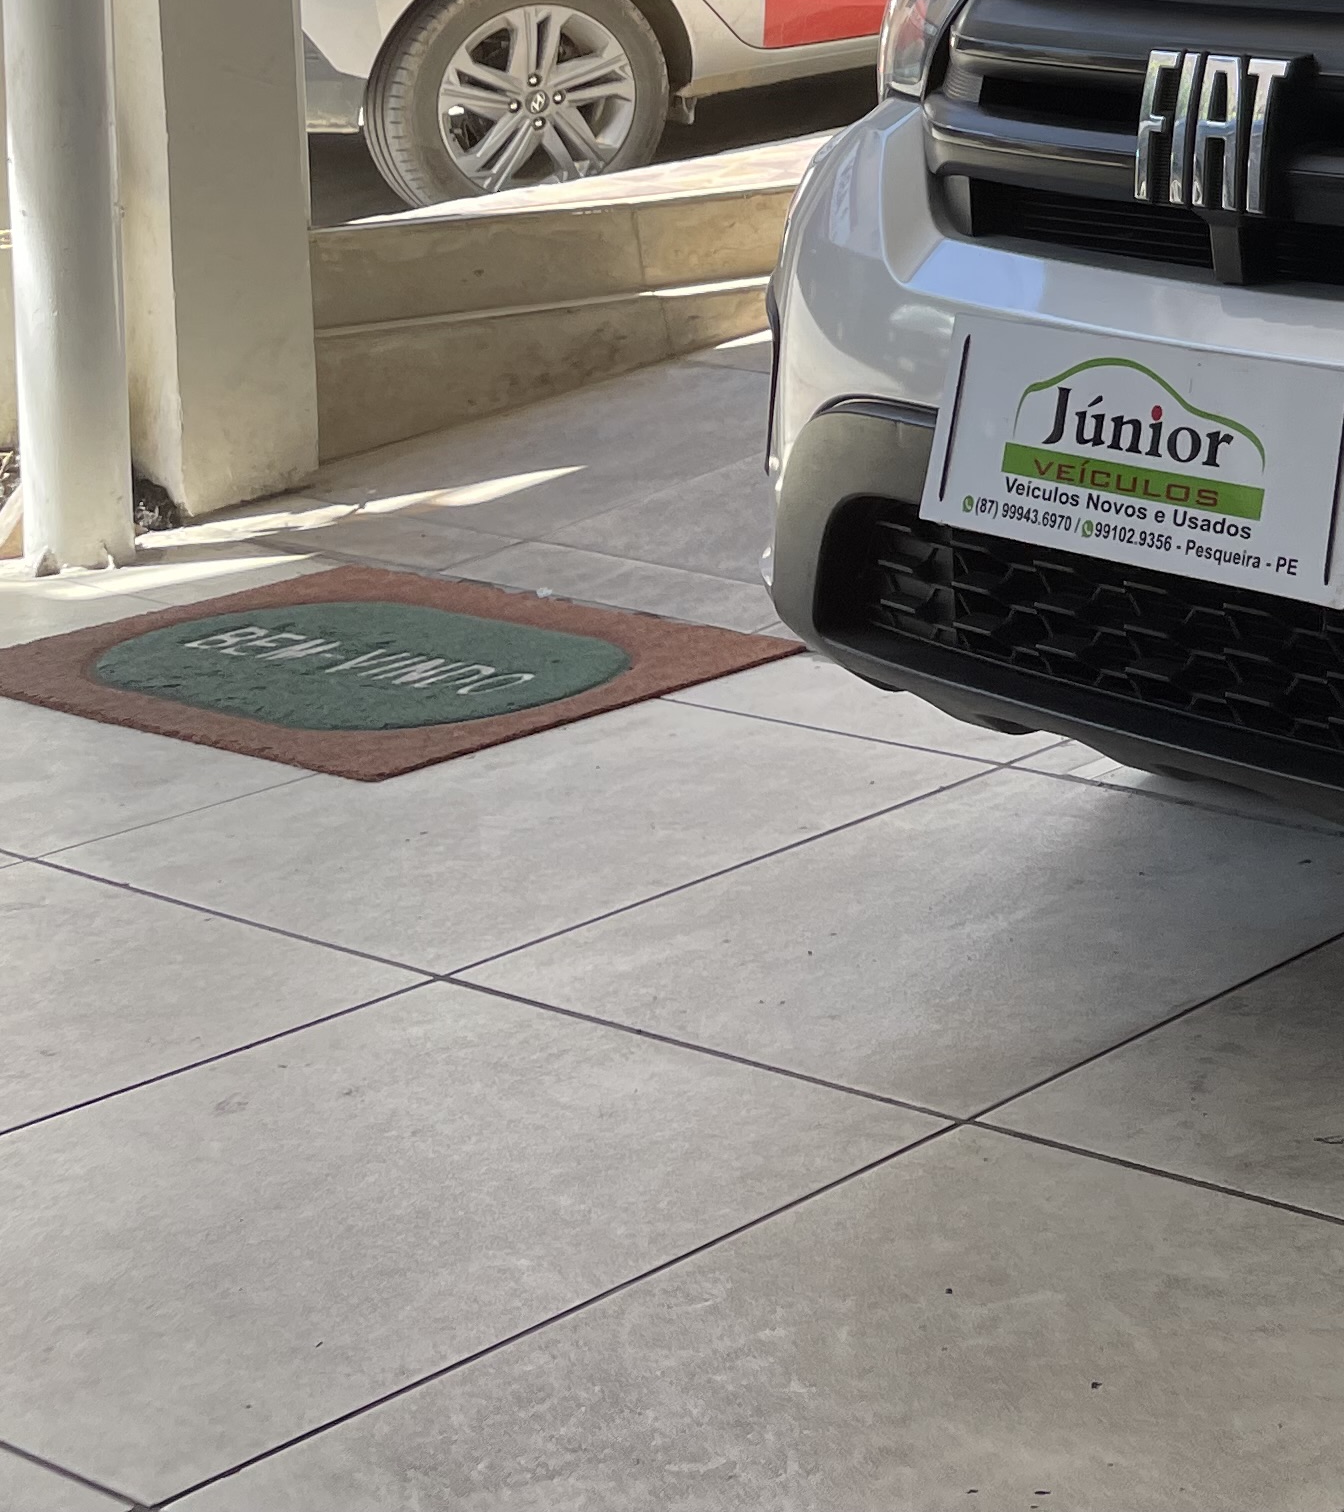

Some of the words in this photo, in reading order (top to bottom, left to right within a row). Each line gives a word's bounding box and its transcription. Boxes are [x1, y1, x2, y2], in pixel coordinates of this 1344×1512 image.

[1134, 49, 1291, 213] FIAT
[1042, 386, 1233, 469] Júnior
[1034, 458, 1219, 508] VEÍCULOS
[1086, 492, 1148, 520] Novos
[1154, 509, 1166, 523] e
[1172, 508, 1253, 540] Usados
[975, 496, 999, 520] (87)
[1001, 502, 1073, 531] 99943.6970
[1094, 521, 1173, 552] 99102.9356
[1184, 538, 1262, 570] Pesqueira
[1275, 555, 1299, 577] PE
[183, 625, 536, 696] BEM-VINDO
